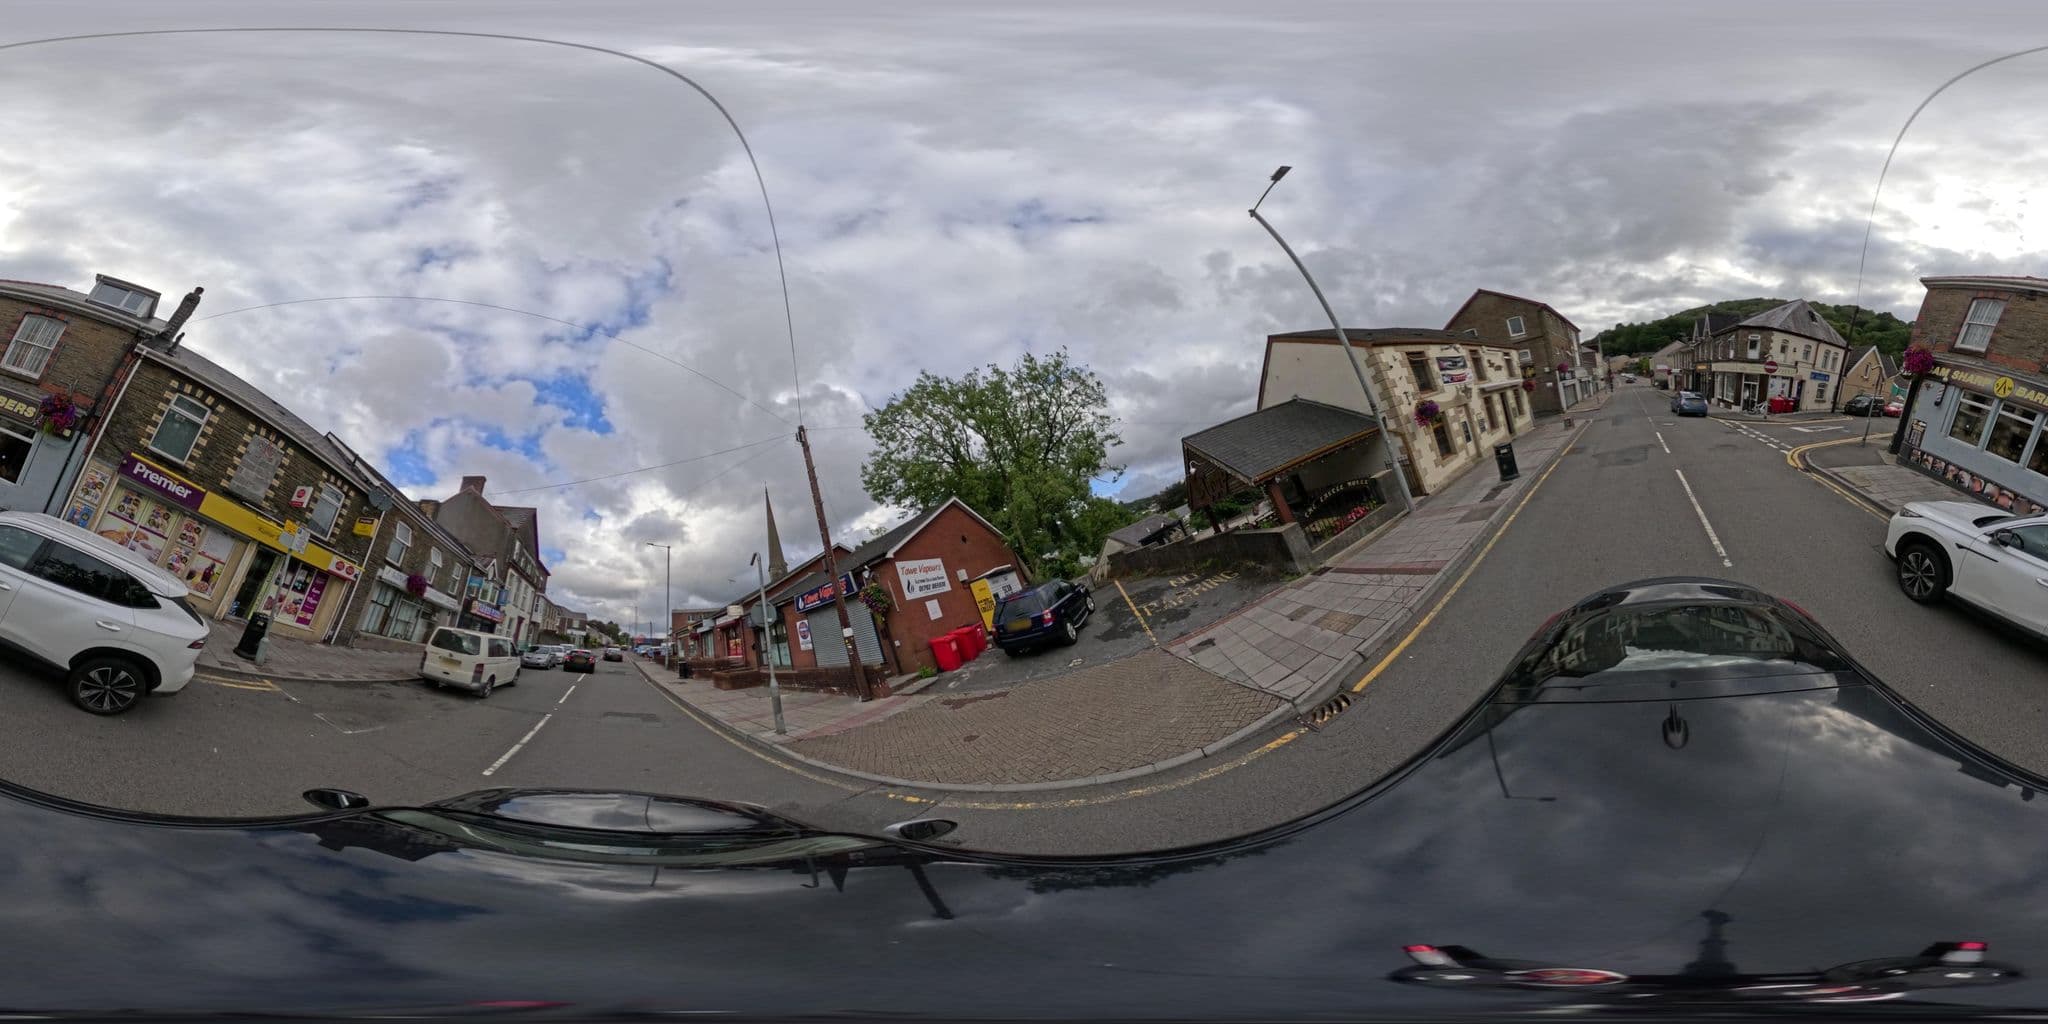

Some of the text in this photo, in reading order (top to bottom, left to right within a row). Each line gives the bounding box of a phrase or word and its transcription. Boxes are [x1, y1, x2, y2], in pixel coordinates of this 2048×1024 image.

[1928, 366, 1950, 377] AM
[132, 462, 191, 498] Premier
[901, 563, 942, 576] Tawe Vapours
[1168, 572, 1199, 587] NO
[804, 580, 847, 604] Tawe Vaps
